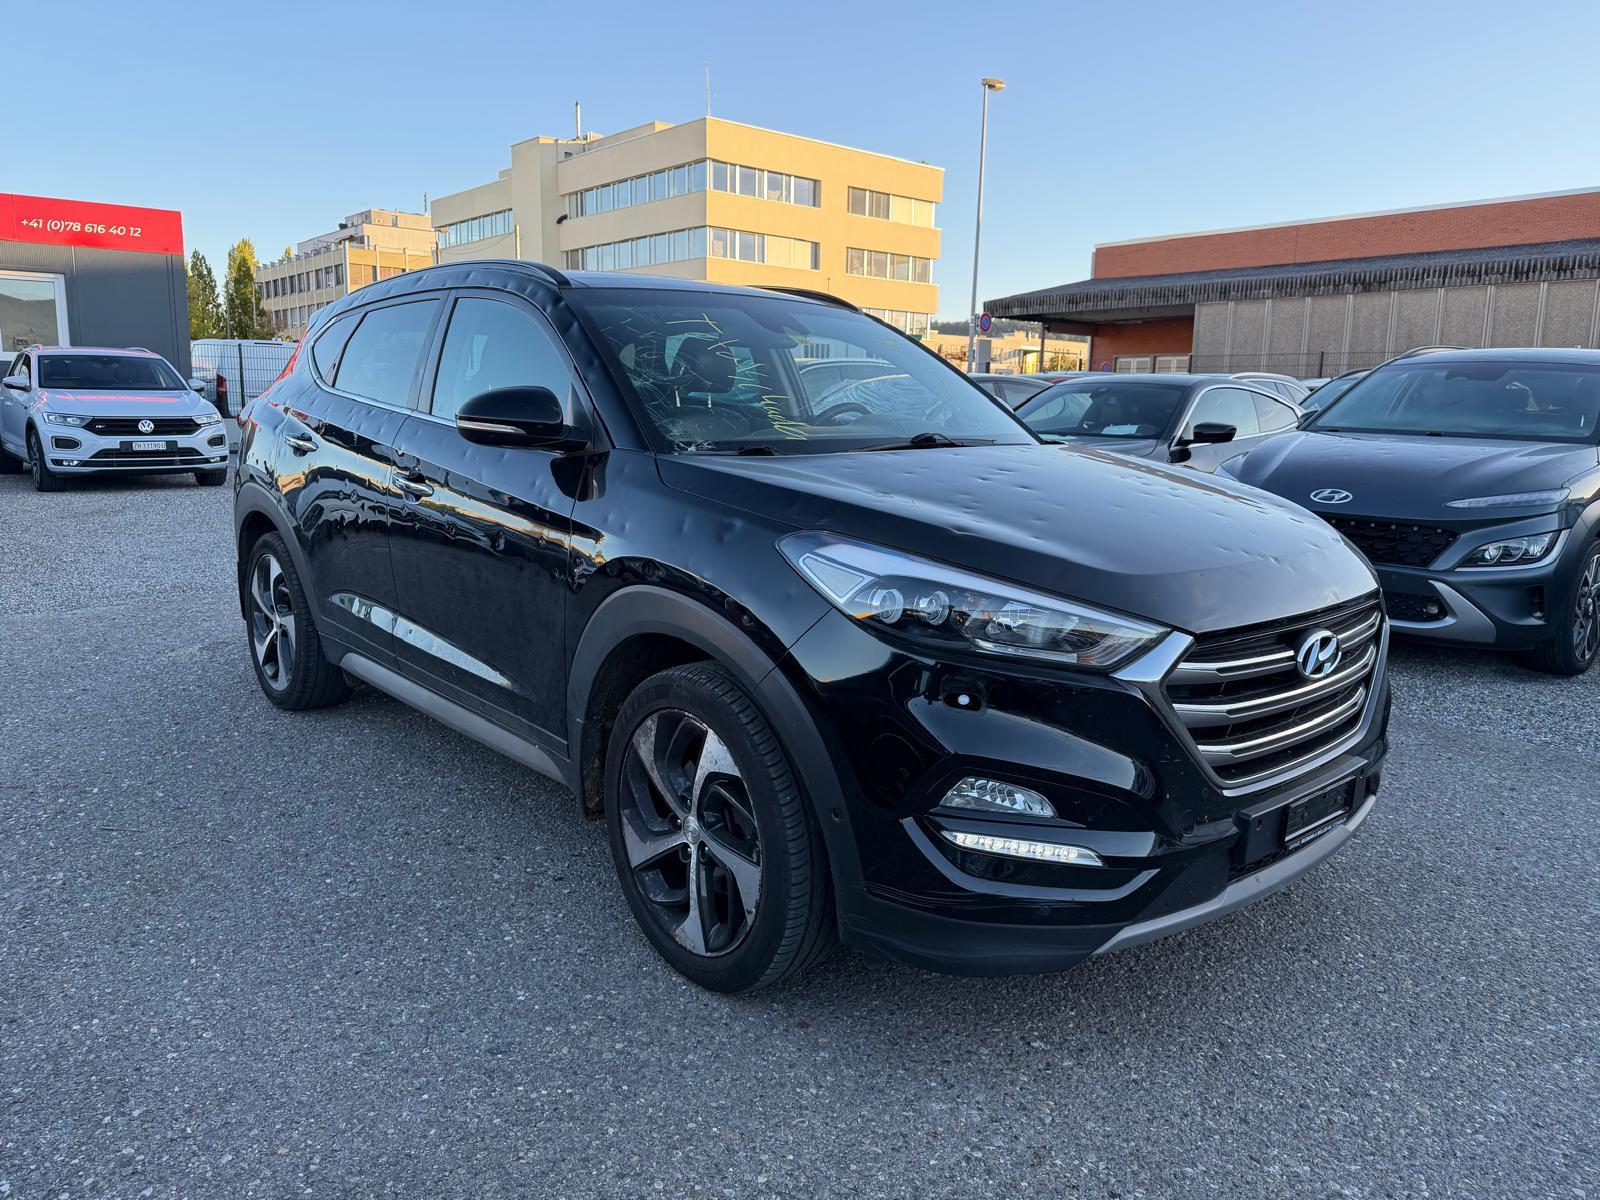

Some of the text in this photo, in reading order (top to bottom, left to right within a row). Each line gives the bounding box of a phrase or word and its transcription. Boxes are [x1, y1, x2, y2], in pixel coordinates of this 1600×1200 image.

[21, 218, 142, 237] +41 (0)78 616 40 12
